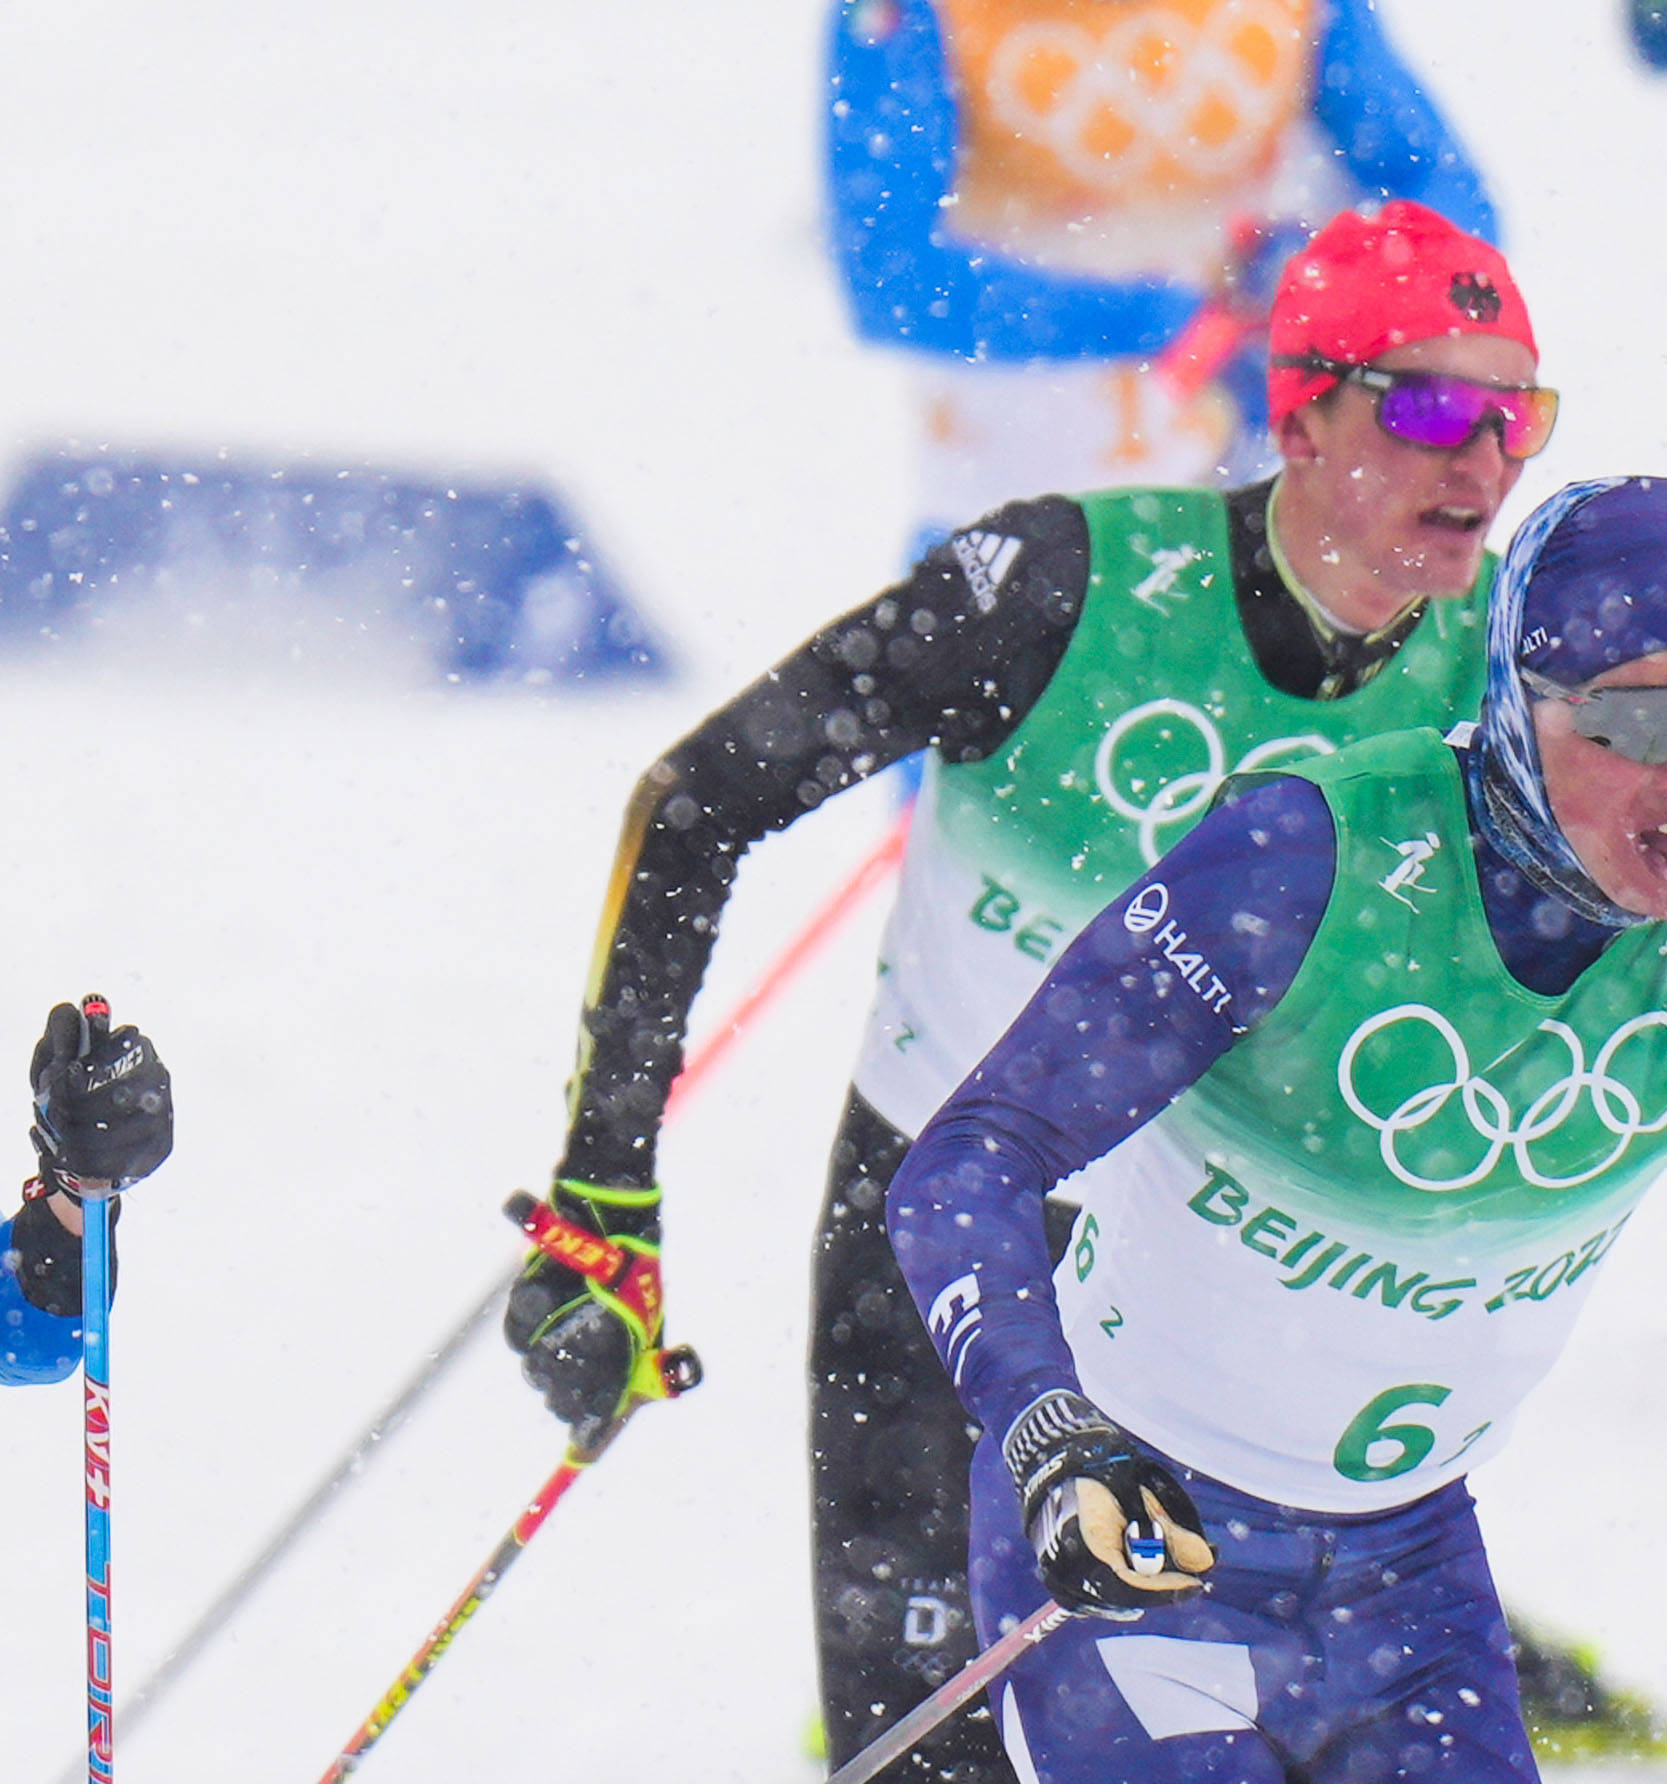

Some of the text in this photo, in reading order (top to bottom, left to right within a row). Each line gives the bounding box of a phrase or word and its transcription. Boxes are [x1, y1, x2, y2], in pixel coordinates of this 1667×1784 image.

[951, 535, 998, 615] adidas
[1075, 1213, 1100, 1283] 6
[1187, 1161, 1476, 1321] BEIJING
[1333, 1383, 1452, 1482] 6
